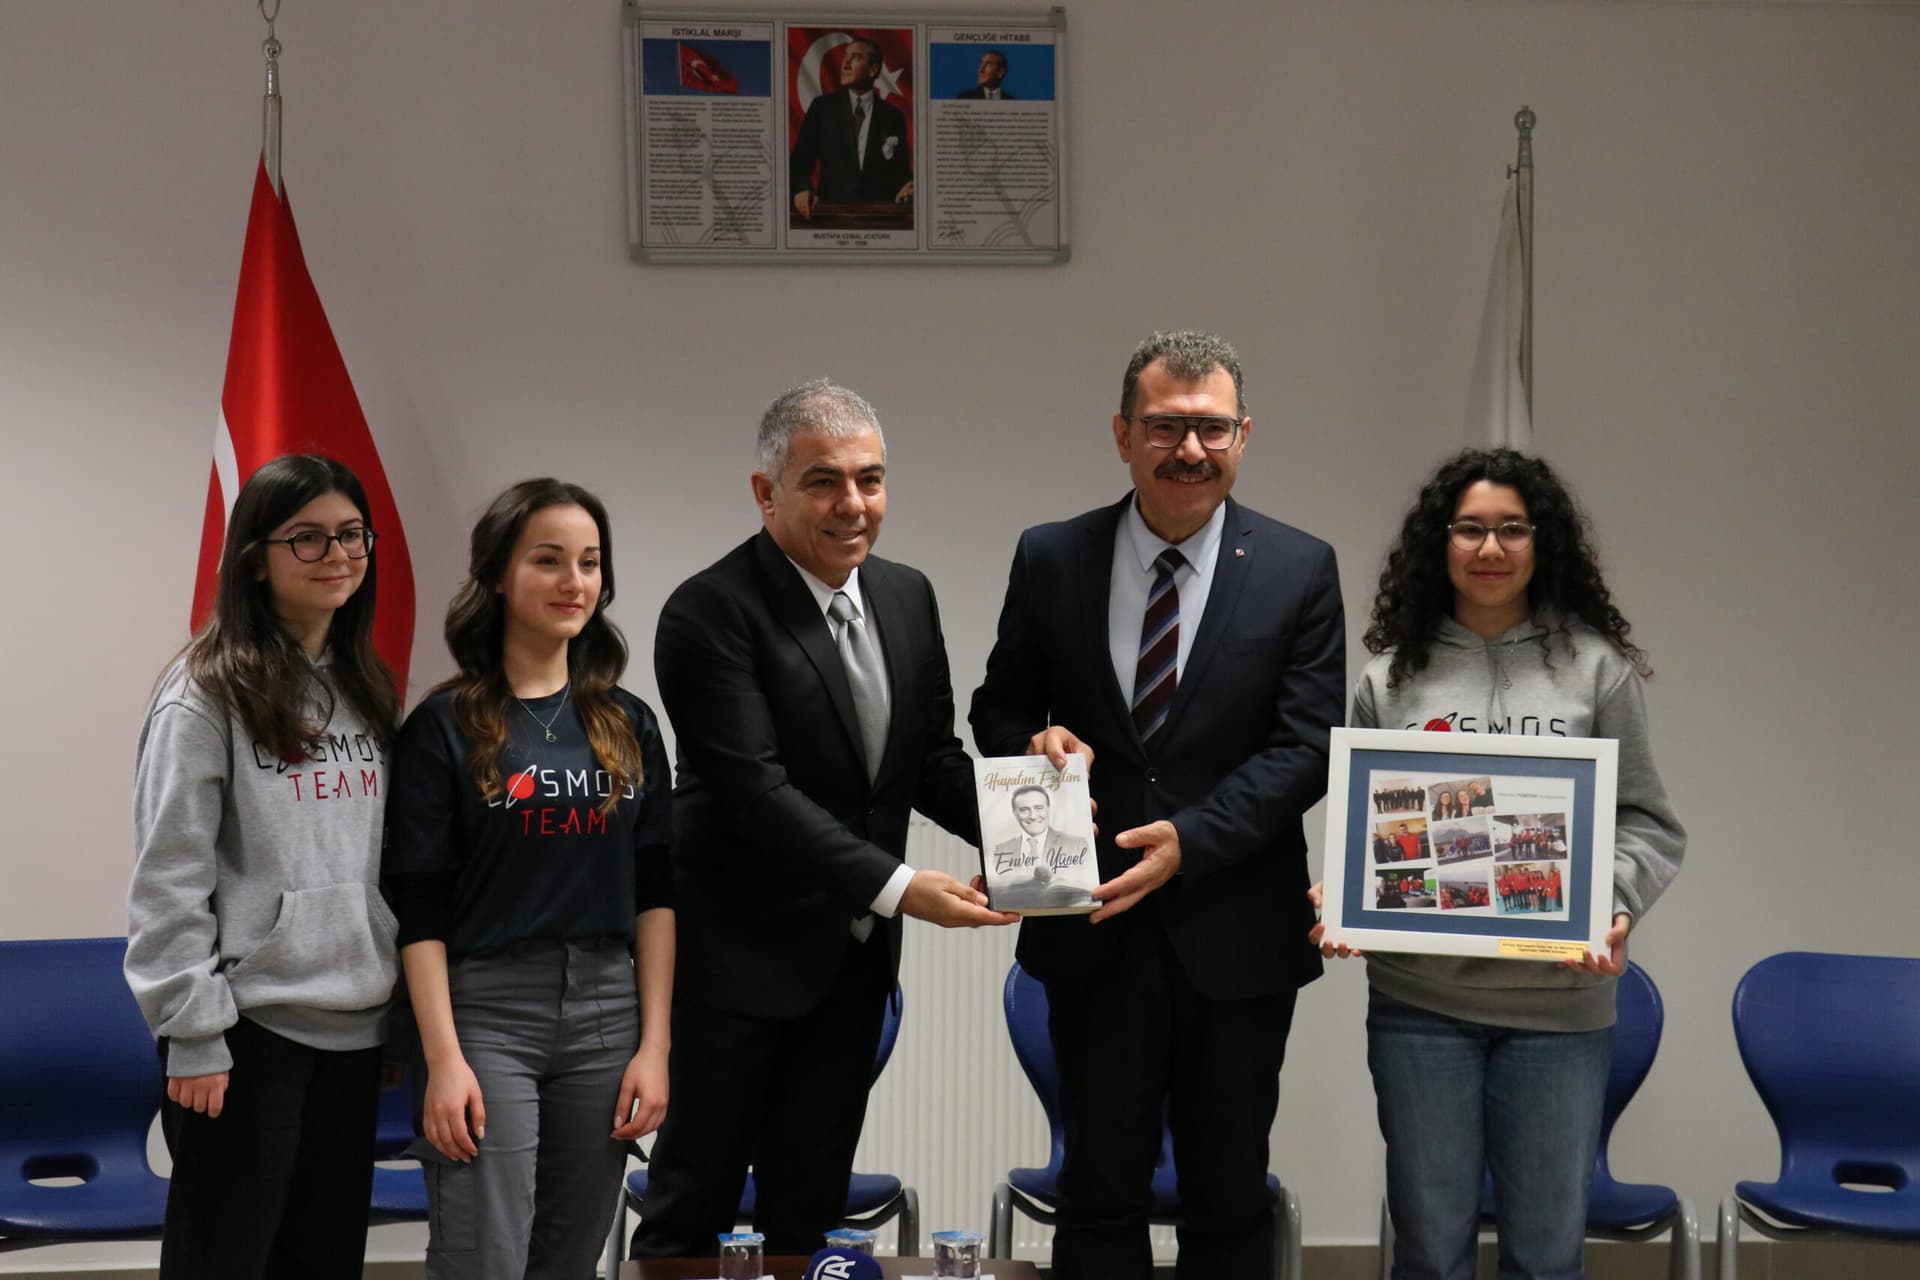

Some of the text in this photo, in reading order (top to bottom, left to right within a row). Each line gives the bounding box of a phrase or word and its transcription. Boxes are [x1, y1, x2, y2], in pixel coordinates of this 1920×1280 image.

[287, 769, 378, 801] TEAM
[520, 807, 607, 836] TEAM
[993, 846, 1088, 875] Enver Yücel
